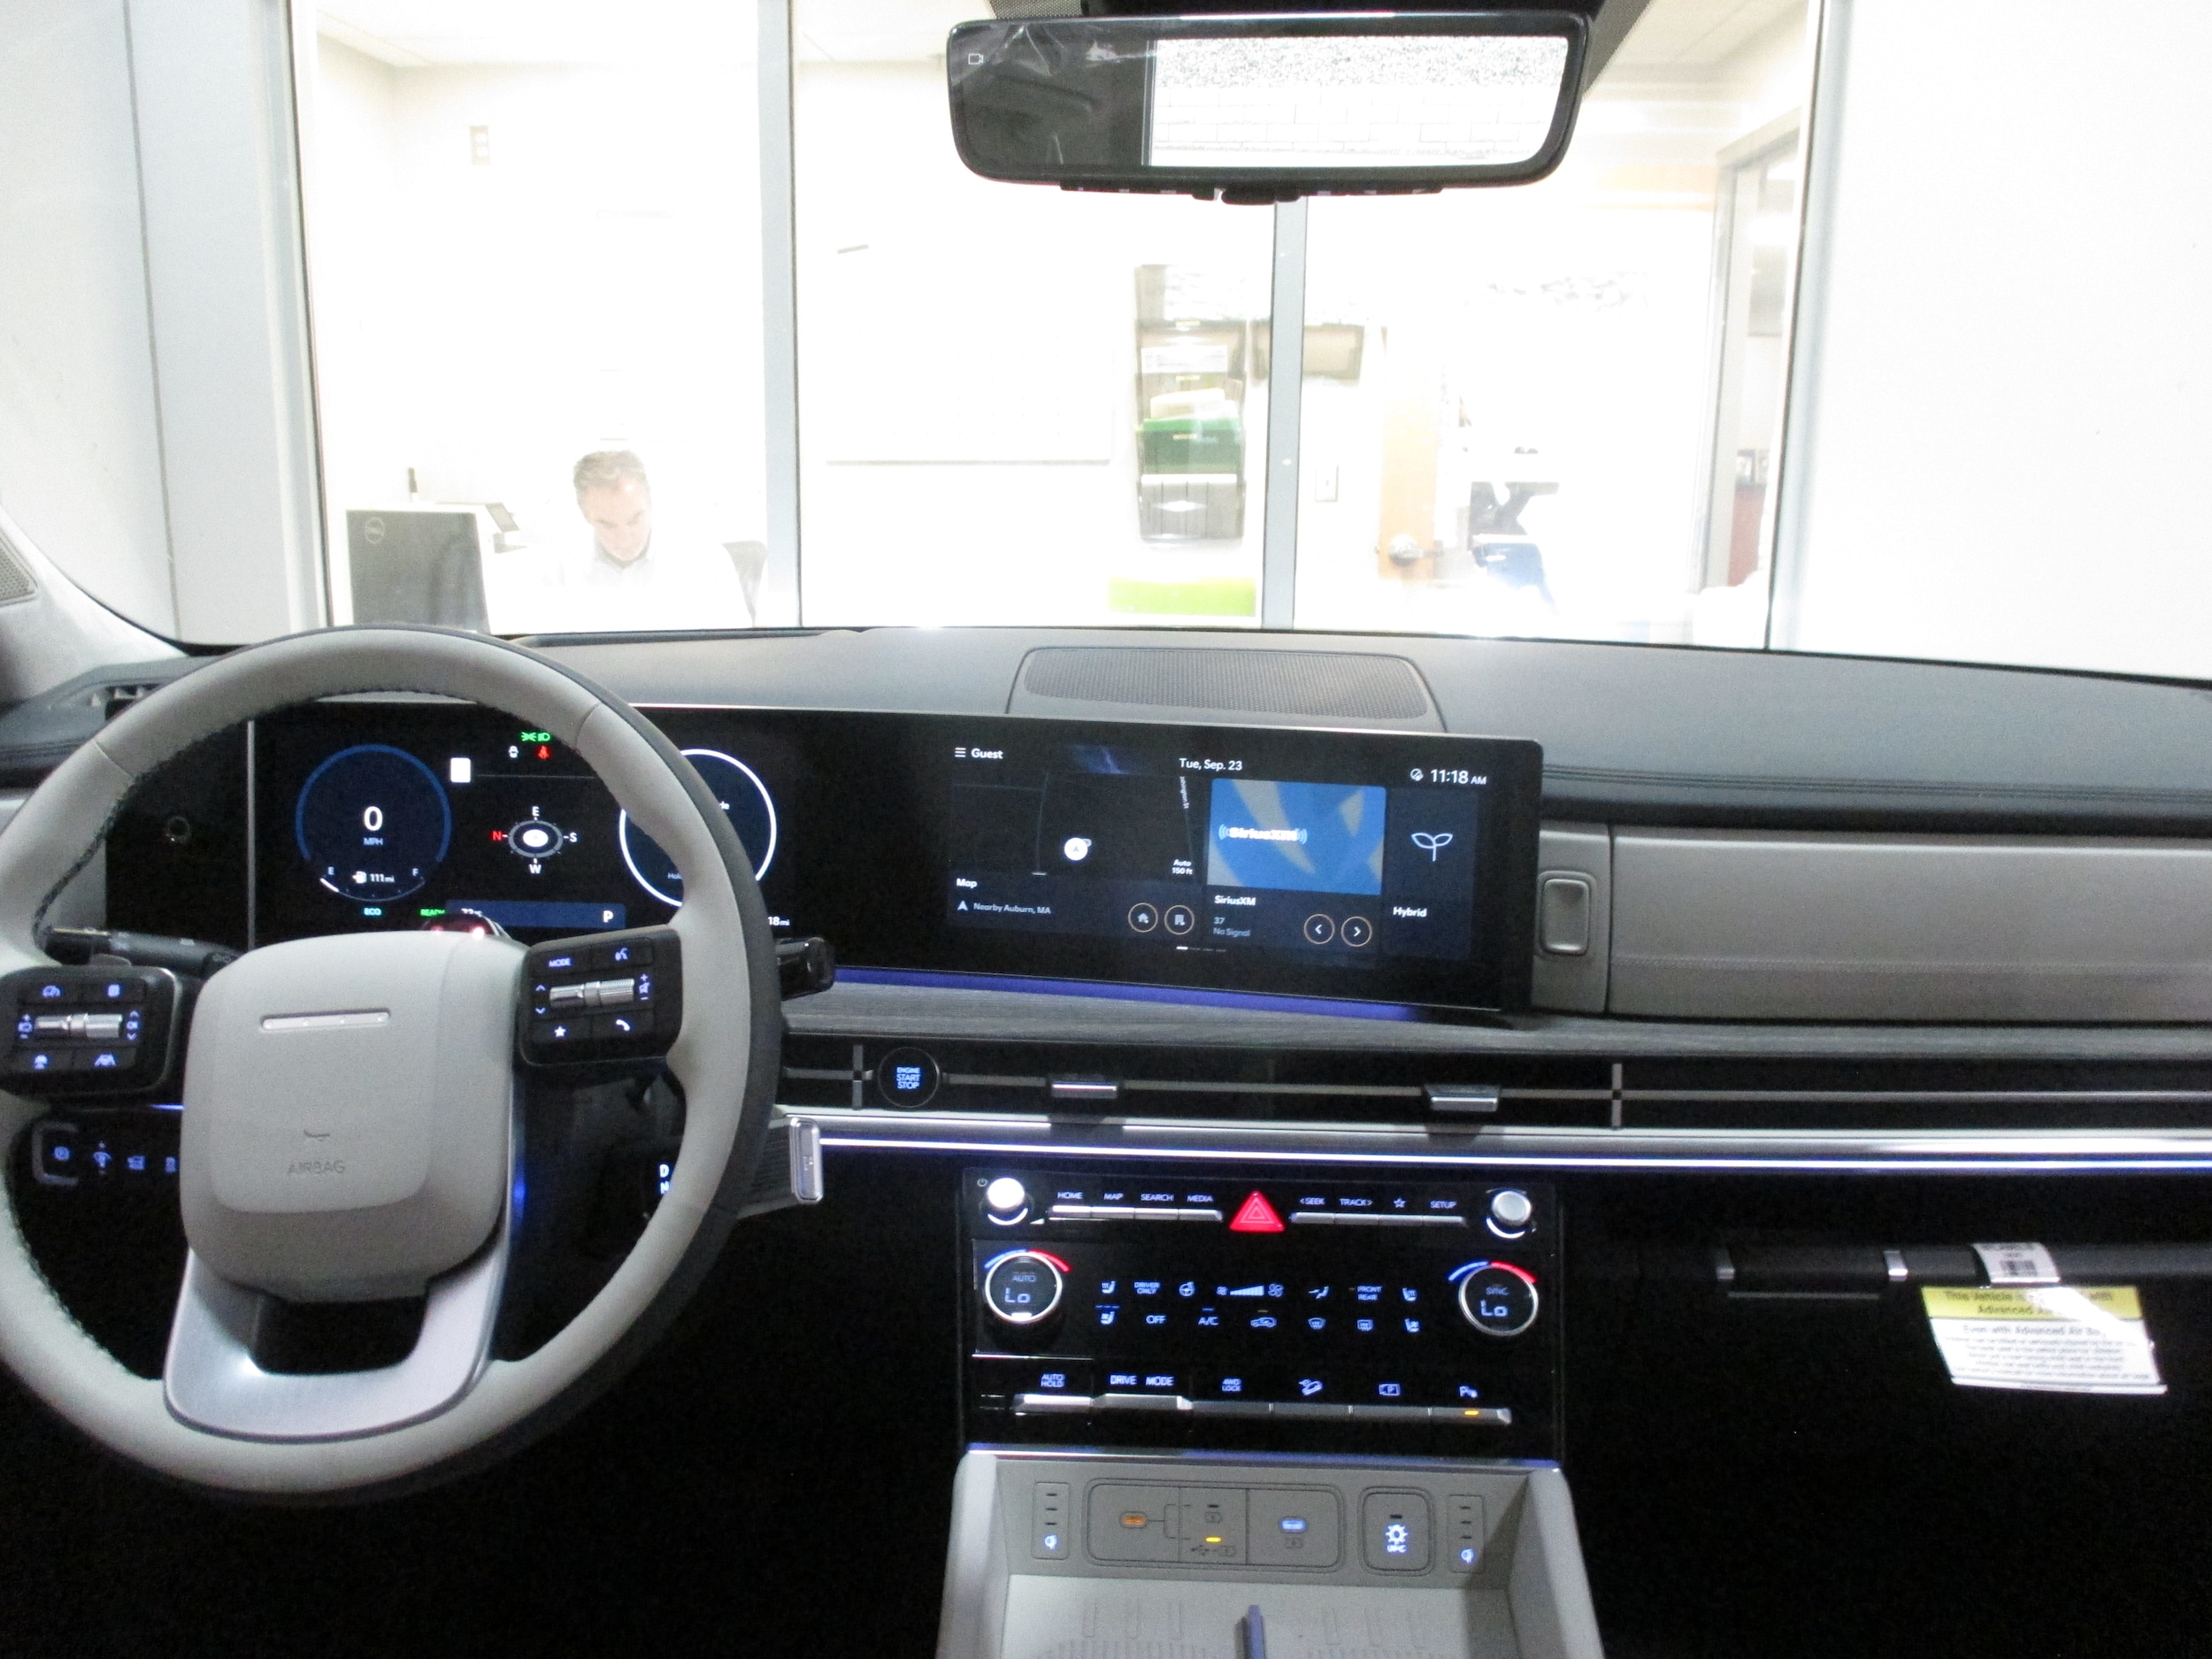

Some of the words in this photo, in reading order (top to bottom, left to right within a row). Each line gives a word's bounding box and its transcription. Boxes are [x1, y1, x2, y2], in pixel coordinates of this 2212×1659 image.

[971, 746, 1003, 760] Guest
[1179, 757, 1202, 770] Tue,
[1203, 757, 1226, 772] Sep.
[1227, 758, 1243, 772] 23
[1430, 767, 1469, 785] 11:18
[1470, 775, 1487, 787] AM
[531, 805, 540, 818] E
[363, 805, 384, 832] 0
[492, 830, 502, 841] N
[569, 832, 579, 843] S
[528, 864, 541, 875] W
[956, 878, 978, 889] Map
[1214, 895, 1256, 907] SiriusXM
[973, 902, 1003, 912] Nearby
[1037, 906, 1053, 915] MA
[1393, 906, 1428, 918] Hybrid
[603, 910, 614, 924] P
[1213, 916, 1225, 926] 37
[549, 957, 572, 968] MODE
[287, 1158, 346, 1175] AIRBAG
[659, 1164, 670, 1178] D
[1057, 1191, 1083, 1200] HOME
[1103, 1192, 1124, 1201] MAP
[1140, 1193, 1174, 1202] SEARCH
[1187, 1194, 1213, 1203] MEDIA
[1011, 1274, 1036, 1283] AUTO
[1004, 1286, 1032, 1304] Lo
[1479, 1299, 1509, 1317] Lo
[1146, 1314, 1166, 1325] OFF
[1198, 1316, 1219, 1326] A/C
[1110, 1374, 1137, 1386] DRIVE
[1145, 1376, 1175, 1386] MODE
